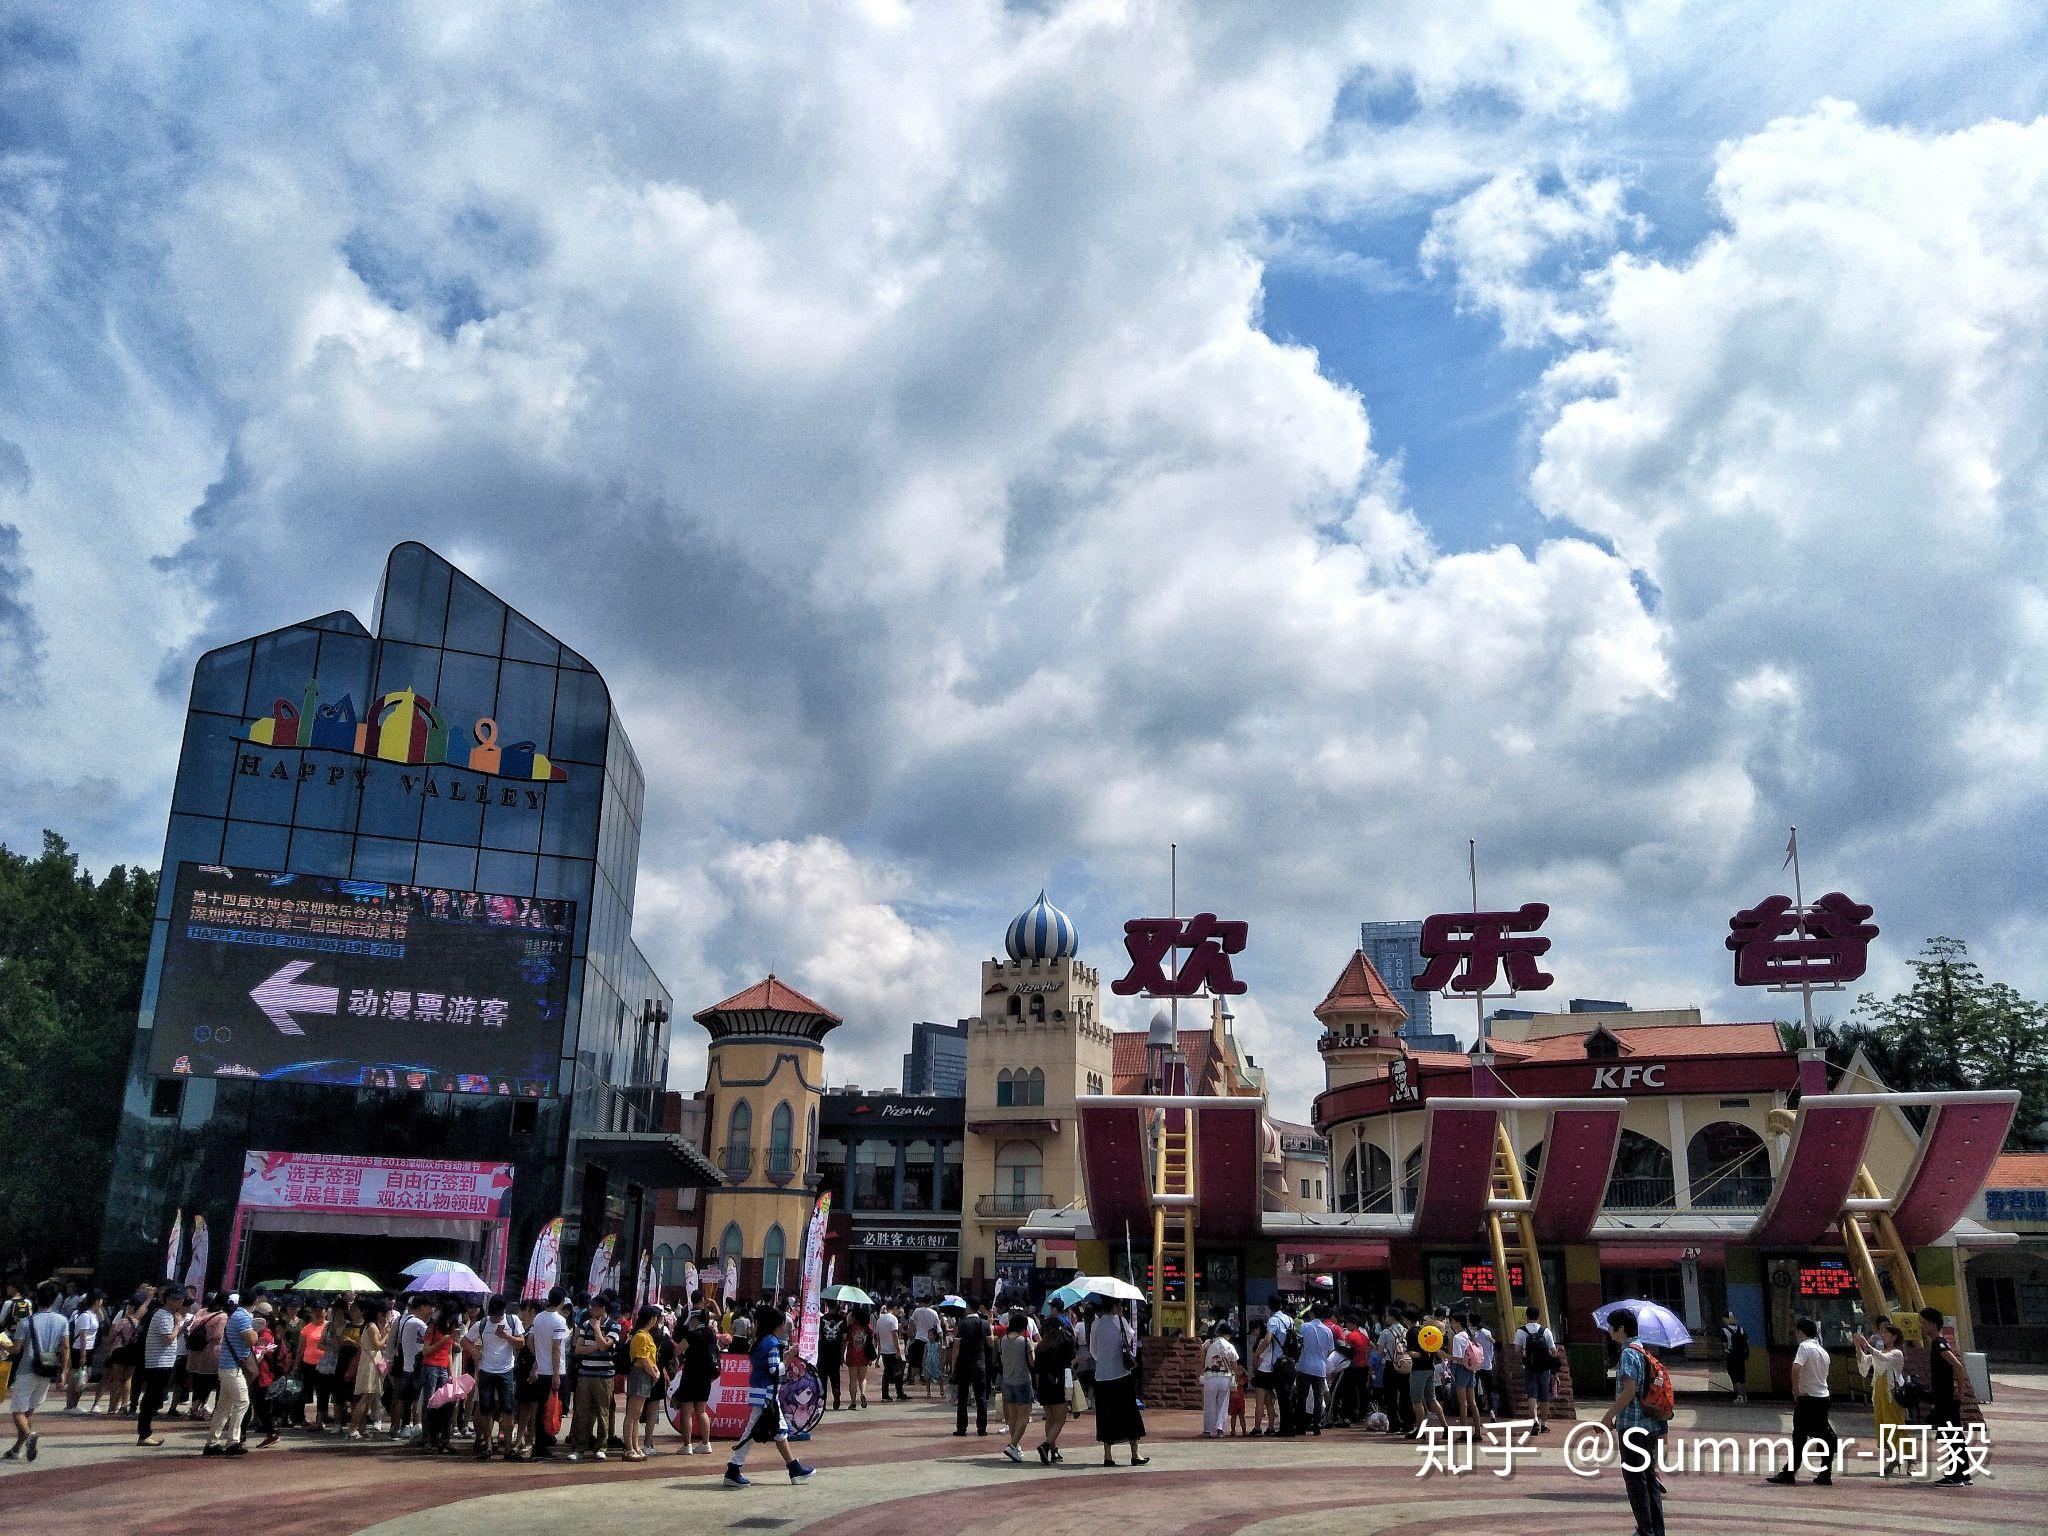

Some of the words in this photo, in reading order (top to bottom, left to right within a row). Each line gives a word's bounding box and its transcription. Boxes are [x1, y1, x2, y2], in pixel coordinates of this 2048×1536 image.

[239, 754, 372, 789] HAPPY
[401, 775, 545, 809] VALLEY
[1111, 913, 1248, 996] 欢
[1411, 903, 1555, 992] 乐
[1725, 891, 1881, 987] 谷
[348, 988, 509, 1027] 动漫票游客
[1338, 1036, 1369, 1048] KFC
[1592, 1065, 1666, 1089] KFC
[882, 1104, 912, 1117] Pizza
[912, 1104, 936, 1116] Hut
[287, 1165, 363, 1187] 选手签到
[386, 1171, 477, 1193] 自由行签到
[284, 1184, 361, 1206] 漫展售票
[377, 1190, 489, 1212] 观众礼物领取
[863, 1232, 904, 1246] 必胜客
[906, 1234, 947, 1247] 欢乐餐厅
[721, 1389, 748, 1403] 跟我
